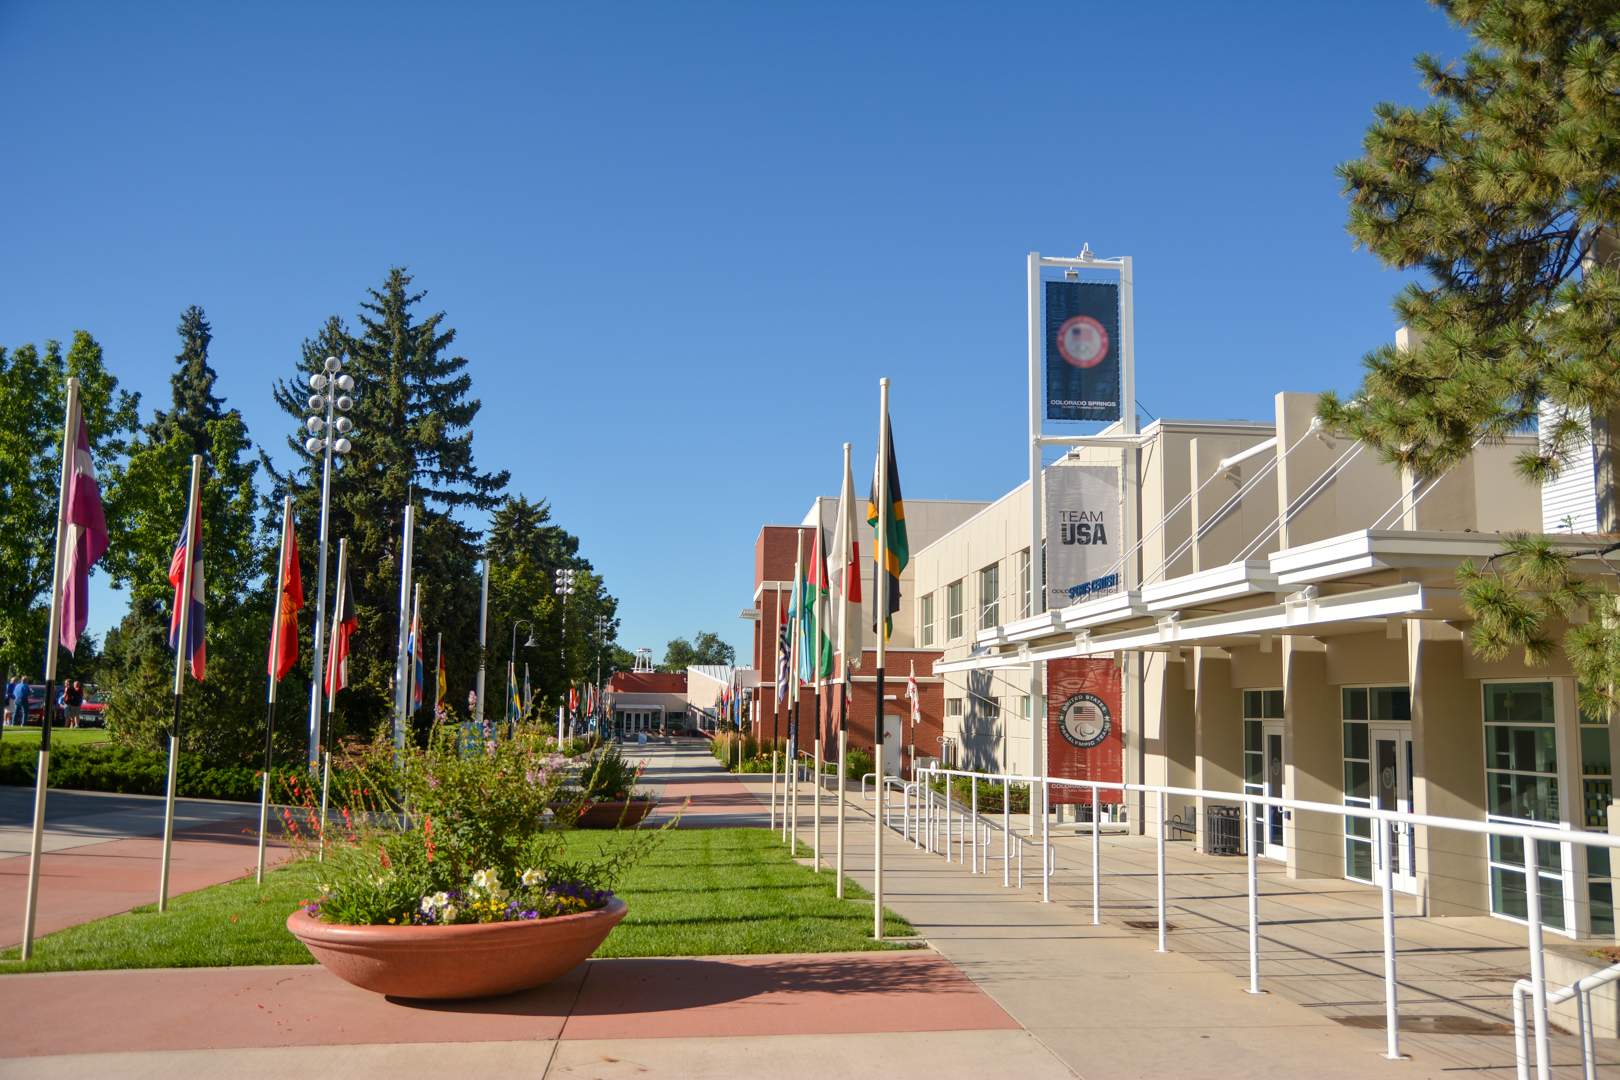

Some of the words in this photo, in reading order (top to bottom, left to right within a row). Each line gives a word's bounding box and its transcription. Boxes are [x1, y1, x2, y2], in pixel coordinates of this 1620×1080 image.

[1060, 511, 1103, 522] TEAM
[1061, 523, 1107, 545] USA
[1062, 695, 1083, 711] UNITED
[1085, 695, 1107, 711] STATES
